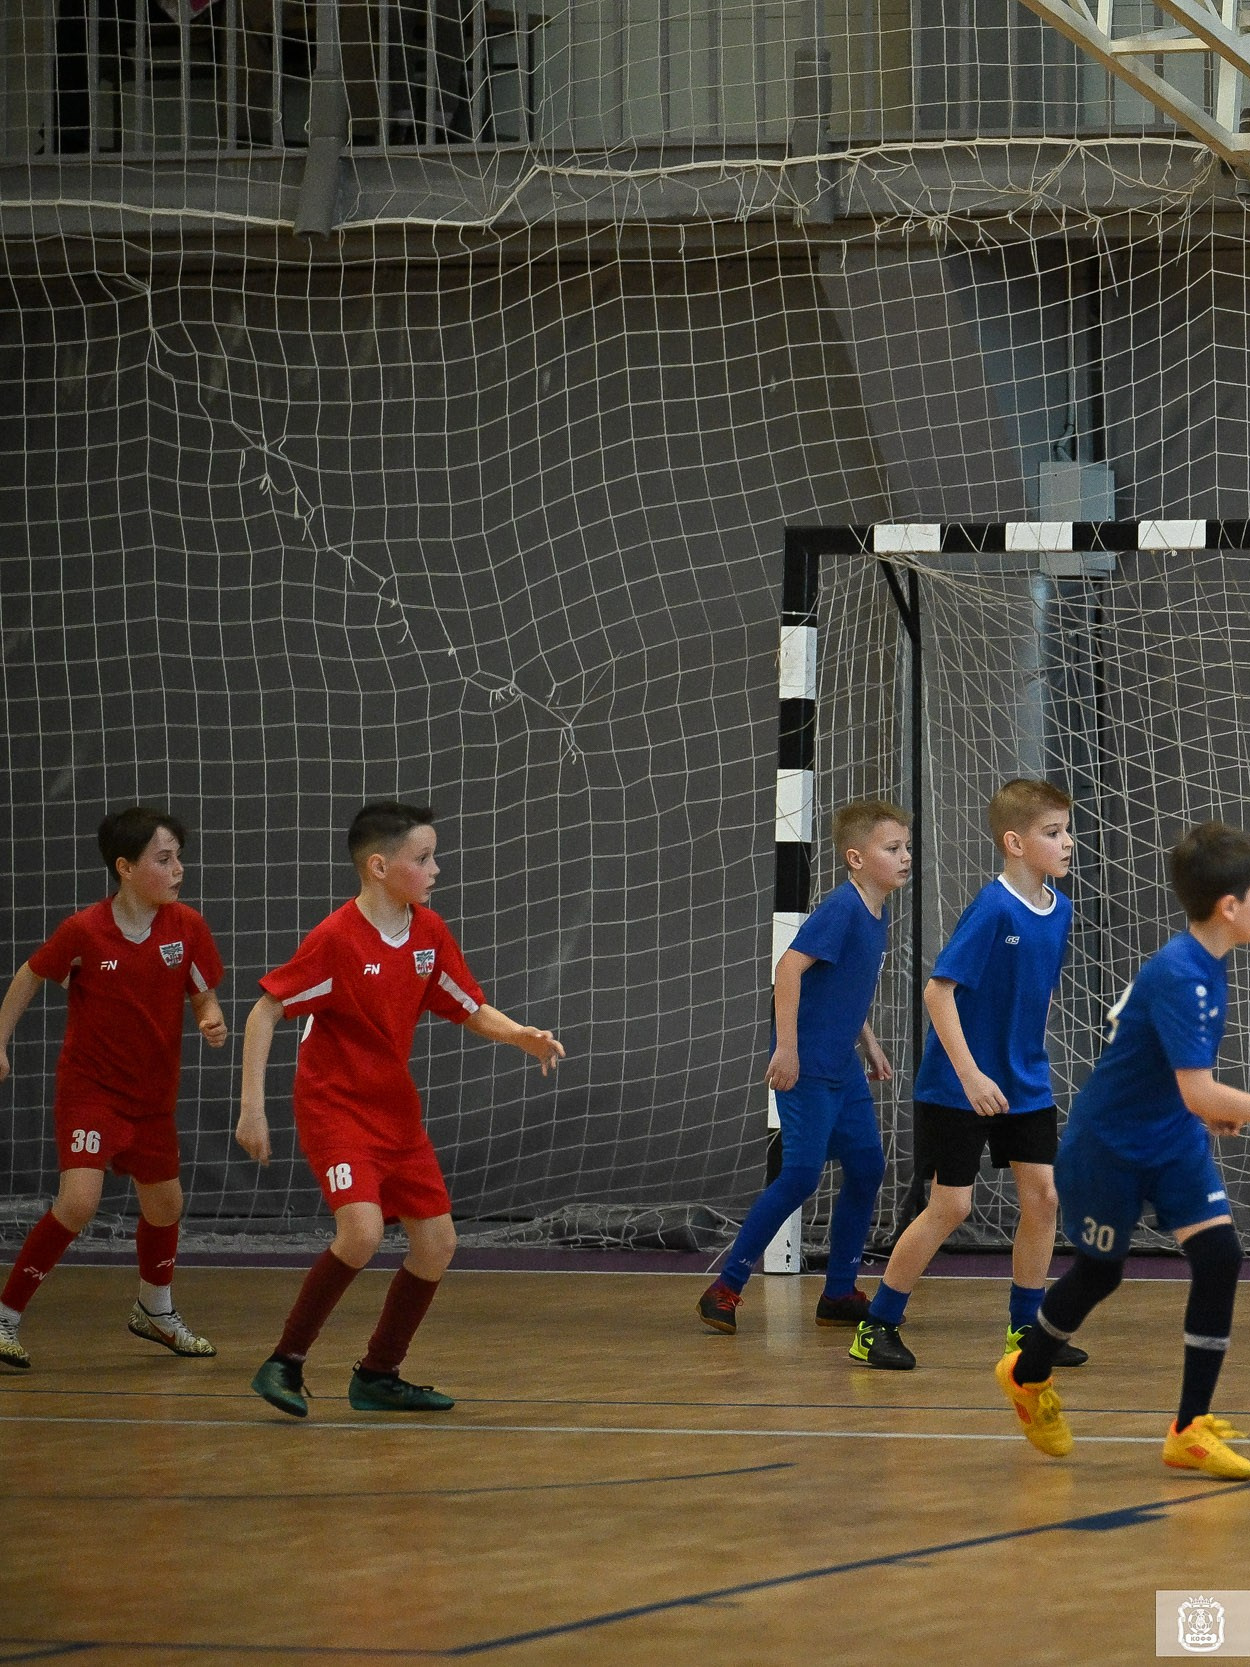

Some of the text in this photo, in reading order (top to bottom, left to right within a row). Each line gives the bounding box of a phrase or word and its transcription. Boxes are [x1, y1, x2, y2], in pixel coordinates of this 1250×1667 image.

[100, 959, 118, 971] FN
[363, 963, 381, 975] FN
[70, 1129, 102, 1154] 36
[326, 1162, 353, 1194] 18
[1082, 1216, 1115, 1252] 30
